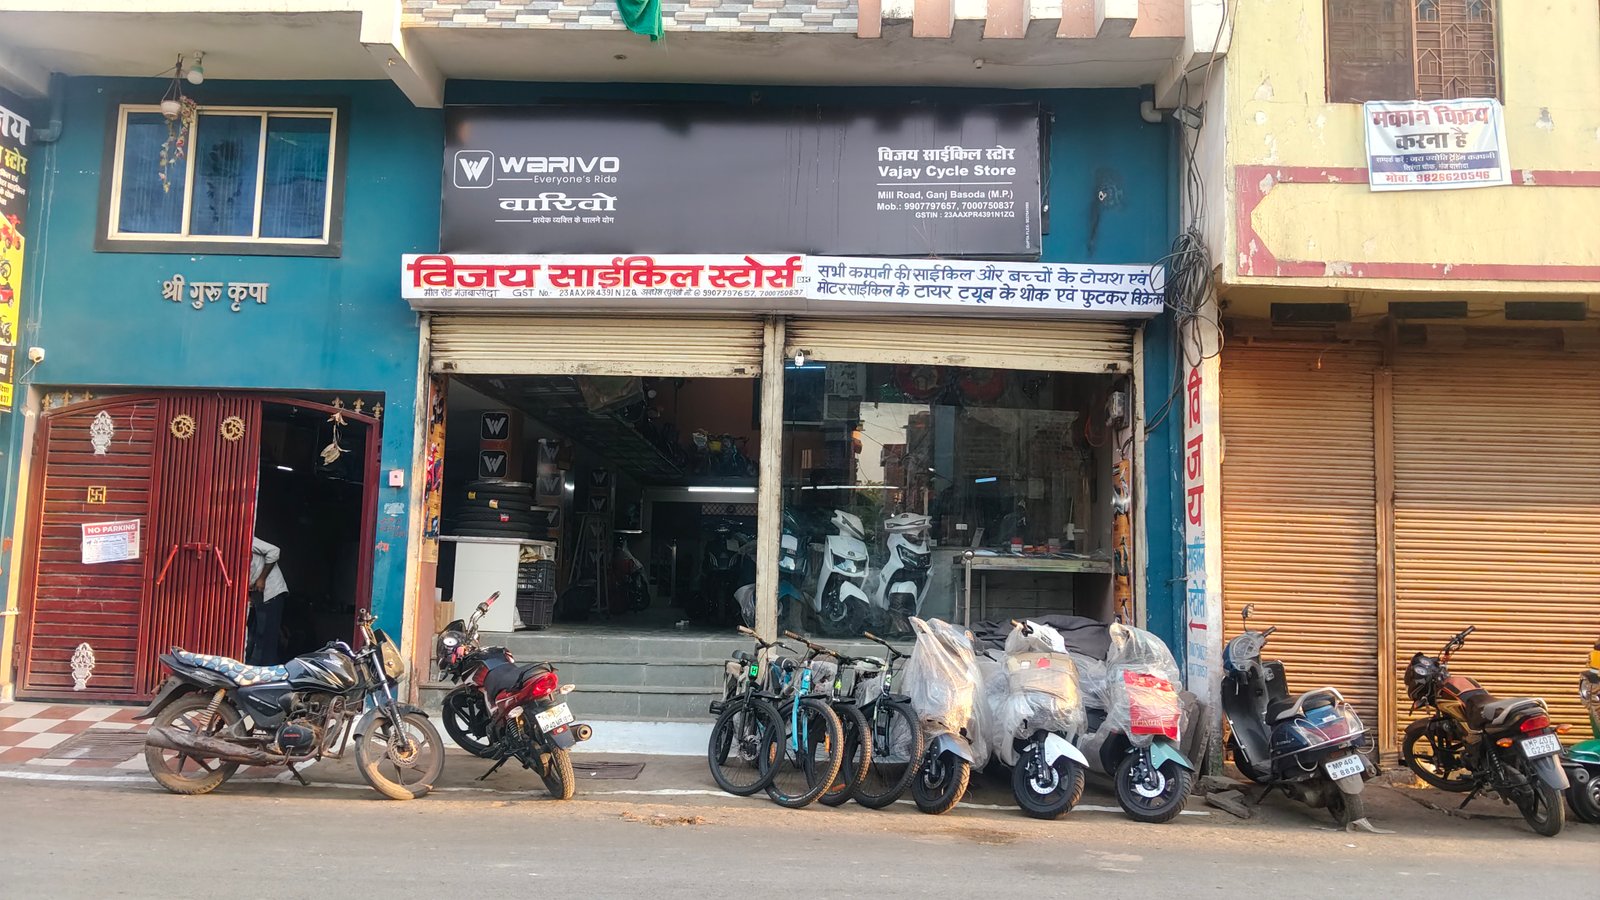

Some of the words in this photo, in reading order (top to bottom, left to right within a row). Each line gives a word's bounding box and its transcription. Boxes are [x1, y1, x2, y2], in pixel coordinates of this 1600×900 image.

[1371, 109, 1431, 128] मकान
[1433, 105, 1490, 126] विक्रय
[1394, 132, 1450, 150] करना
[1450, 127, 1469, 148] है
[5, 146, 28, 175] स्टोर
[878, 146, 920, 162] विजय
[923, 145, 982, 162] साईकिल
[985, 145, 1016, 160] स्टोर
[533, 174, 591, 185] Everyone's
[594, 174, 618, 184] Ride
[878, 165, 921, 179] Vajay
[926, 165, 969, 179] Cycle
[973, 164, 1017, 176] Store
[498, 191, 618, 212] वारिवो
[877, 191, 894, 199] Mill
[896, 190, 924, 200] Road,
[926, 190, 949, 201] Ganj
[950, 190, 986, 199] Basoda
[988, 189, 1013, 200] (M.P.)
[877, 202, 902, 211] Mob.:
[904, 202, 959, 211] 9907797657,
[961, 201, 1015, 210] 7000750837
[532, 215, 551, 224] प्रत्येक
[574, 215, 581, 224] के
[915, 211, 938, 219] GSTIN
[407, 255, 542, 288] विजय
[548, 255, 704, 288] साईकिल
[708, 255, 802, 288] स्टोर्स
[818, 262, 847, 278] सभी
[849, 263, 892, 280] कम्पनी
[894, 263, 912, 281] की
[912, 264, 975, 282] साईकिल
[979, 264, 1004, 281] और
[1008, 265, 1053, 283] बच्चों
[1057, 267, 1079, 284] के
[1080, 268, 1125, 285] टोयश
[1128, 269, 1150, 286] एवं
[162, 273, 185, 302] श्री
[227, 281, 270, 312] कृपा
[512, 288, 535, 297] GST
[895, 282, 910, 298] के
[914, 284, 953, 300] टायर
[958, 286, 997, 304] ट्यूब
[999, 283, 1018, 300] के
[1020, 284, 1049, 302] थोक
[1055, 285, 1079, 302] एवं
[1080, 289, 1130, 309] फुटकर
[102, 523, 136, 533] PARKING
